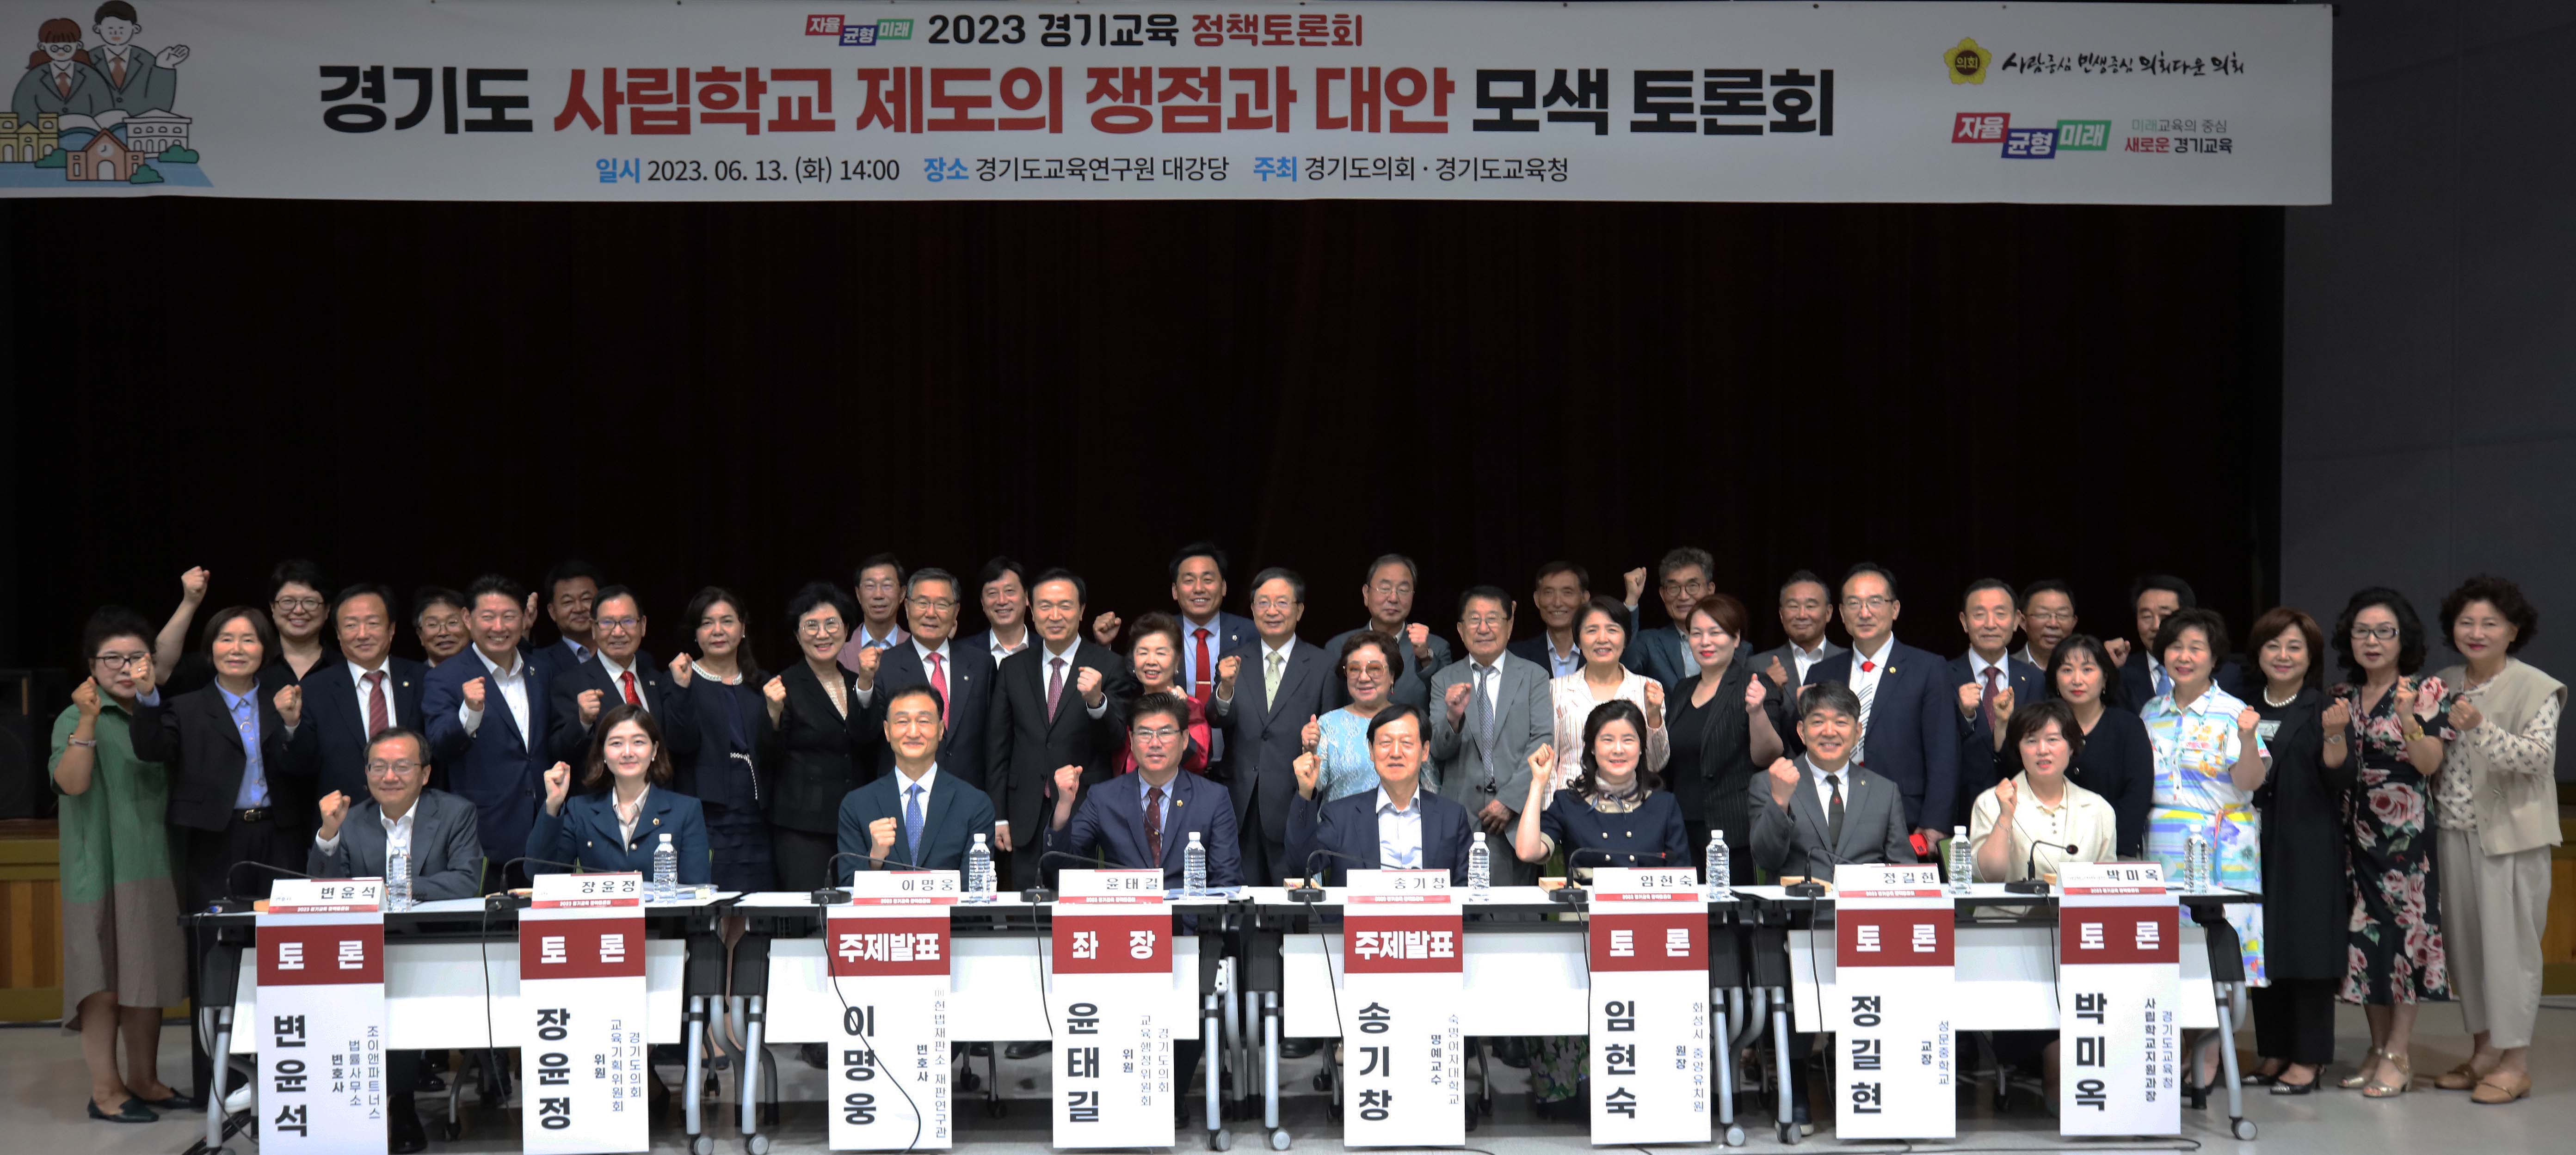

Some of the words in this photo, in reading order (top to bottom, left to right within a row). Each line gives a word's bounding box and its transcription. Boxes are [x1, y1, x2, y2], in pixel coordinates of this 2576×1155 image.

[809, 17, 841, 33] 자율
[843, 25, 875, 45] 균형
[879, 21, 910, 37] 미래
[929, 15, 1025, 44] 2023
[1038, 13, 1179, 47] 경기교육
[1192, 13, 1362, 46] 정책토론회
[1955, 56, 1979, 69] 의회
[2002, 52, 2071, 74] 사람중심
[2078, 52, 2133, 74] 민생중심
[2139, 50, 2206, 76] 의회다운
[2211, 51, 2244, 74] 의회
[320, 65, 533, 134] 경기도
[554, 66, 835, 135] 사립학교
[857, 66, 1062, 133] 제도의
[1086, 66, 1297, 134] 쟁점과
[1316, 67, 1455, 133] 대안
[1473, 68, 1608, 135] 모색
[1630, 68, 1834, 136] 토론회
[1958, 116, 2004, 139] 자율
[2007, 132, 2054, 156] 균형
[2060, 123, 2105, 147] 미래
[2131, 118, 2197, 134] 미래교육의
[2201, 118, 2228, 134] 중심
[2125, 137, 2171, 154] 새로운
[2175, 137, 2233, 154] 경기교육
[596, 158, 640, 183] 일시
[648, 160, 707, 181] 2023.
[715, 160, 747, 181] 06.
[756, 160, 787, 180] 13.
[796, 156, 832, 184] (화)
[841, 160, 899, 180] 14:00
[924, 157, 969, 182] 장소
[976, 157, 1154, 181] 경기도교육연구원
[1163, 157, 1229, 181] 대강당
[1254, 156, 1297, 182] 주최
[1306, 156, 1414, 181] 경기도의회
[1436, 157, 1567, 182] 경기도교육청
[321, 887, 375, 899] 변윤석
[582, 881, 635, 893] 장윤정
[902, 879, 953, 891] 이명웅
[1107, 879, 1157, 889] 윤태길
[1395, 878, 1445, 889] 송기창
[1641, 875, 1691, 886] 임현숙
[1884, 872, 1934, 884] 정길현
[2107, 870, 2157, 881] 박미옥
[839, 933, 940, 962] 주제발표
[1355, 931, 1454, 960] 주제발표
[935, 1001, 945, 1064] 헌법재판소
[1693, 1002, 1702, 1039] 화성시
[594, 1054, 605, 1079] 위원
[611, 1020, 623, 1112] 교육기획위원회
[630, 1032, 641, 1098] 경기도의회
[844, 1006, 876, 1125] 이명웅
[917, 1044, 928, 1081] 변호사
[1067, 1003, 1099, 1122] 윤태길
[1123, 1049, 1133, 1073] 위원
[1141, 1015, 1151, 1106] 교육행정위원회
[1159, 1028, 1168, 1092] 경기도의회
[1359, 1002, 1392, 1121] 송기창
[1431, 1035, 1441, 1085] 명예교수
[1605, 1001, 1636, 1118] 임현숙
[1676, 1045, 1686, 1069] 원장
[1851, 996, 1881, 1113] 정길현
[1922, 1041, 1932, 1065] 교장
[2075, 993, 2107, 1111] 박미옥
[2145, 998, 2156, 1102] 사립학교지원과장
[2163, 1011, 2173, 1088] 경기도교육청
[274, 1015, 307, 1137] 변윤석
[332, 1054, 344, 1093] 변호사
[349, 1040, 361, 1106] 법률사무소
[368, 1026, 380, 1119] 조이앤파트너스
[537, 1008, 570, 1130] 장윤정
